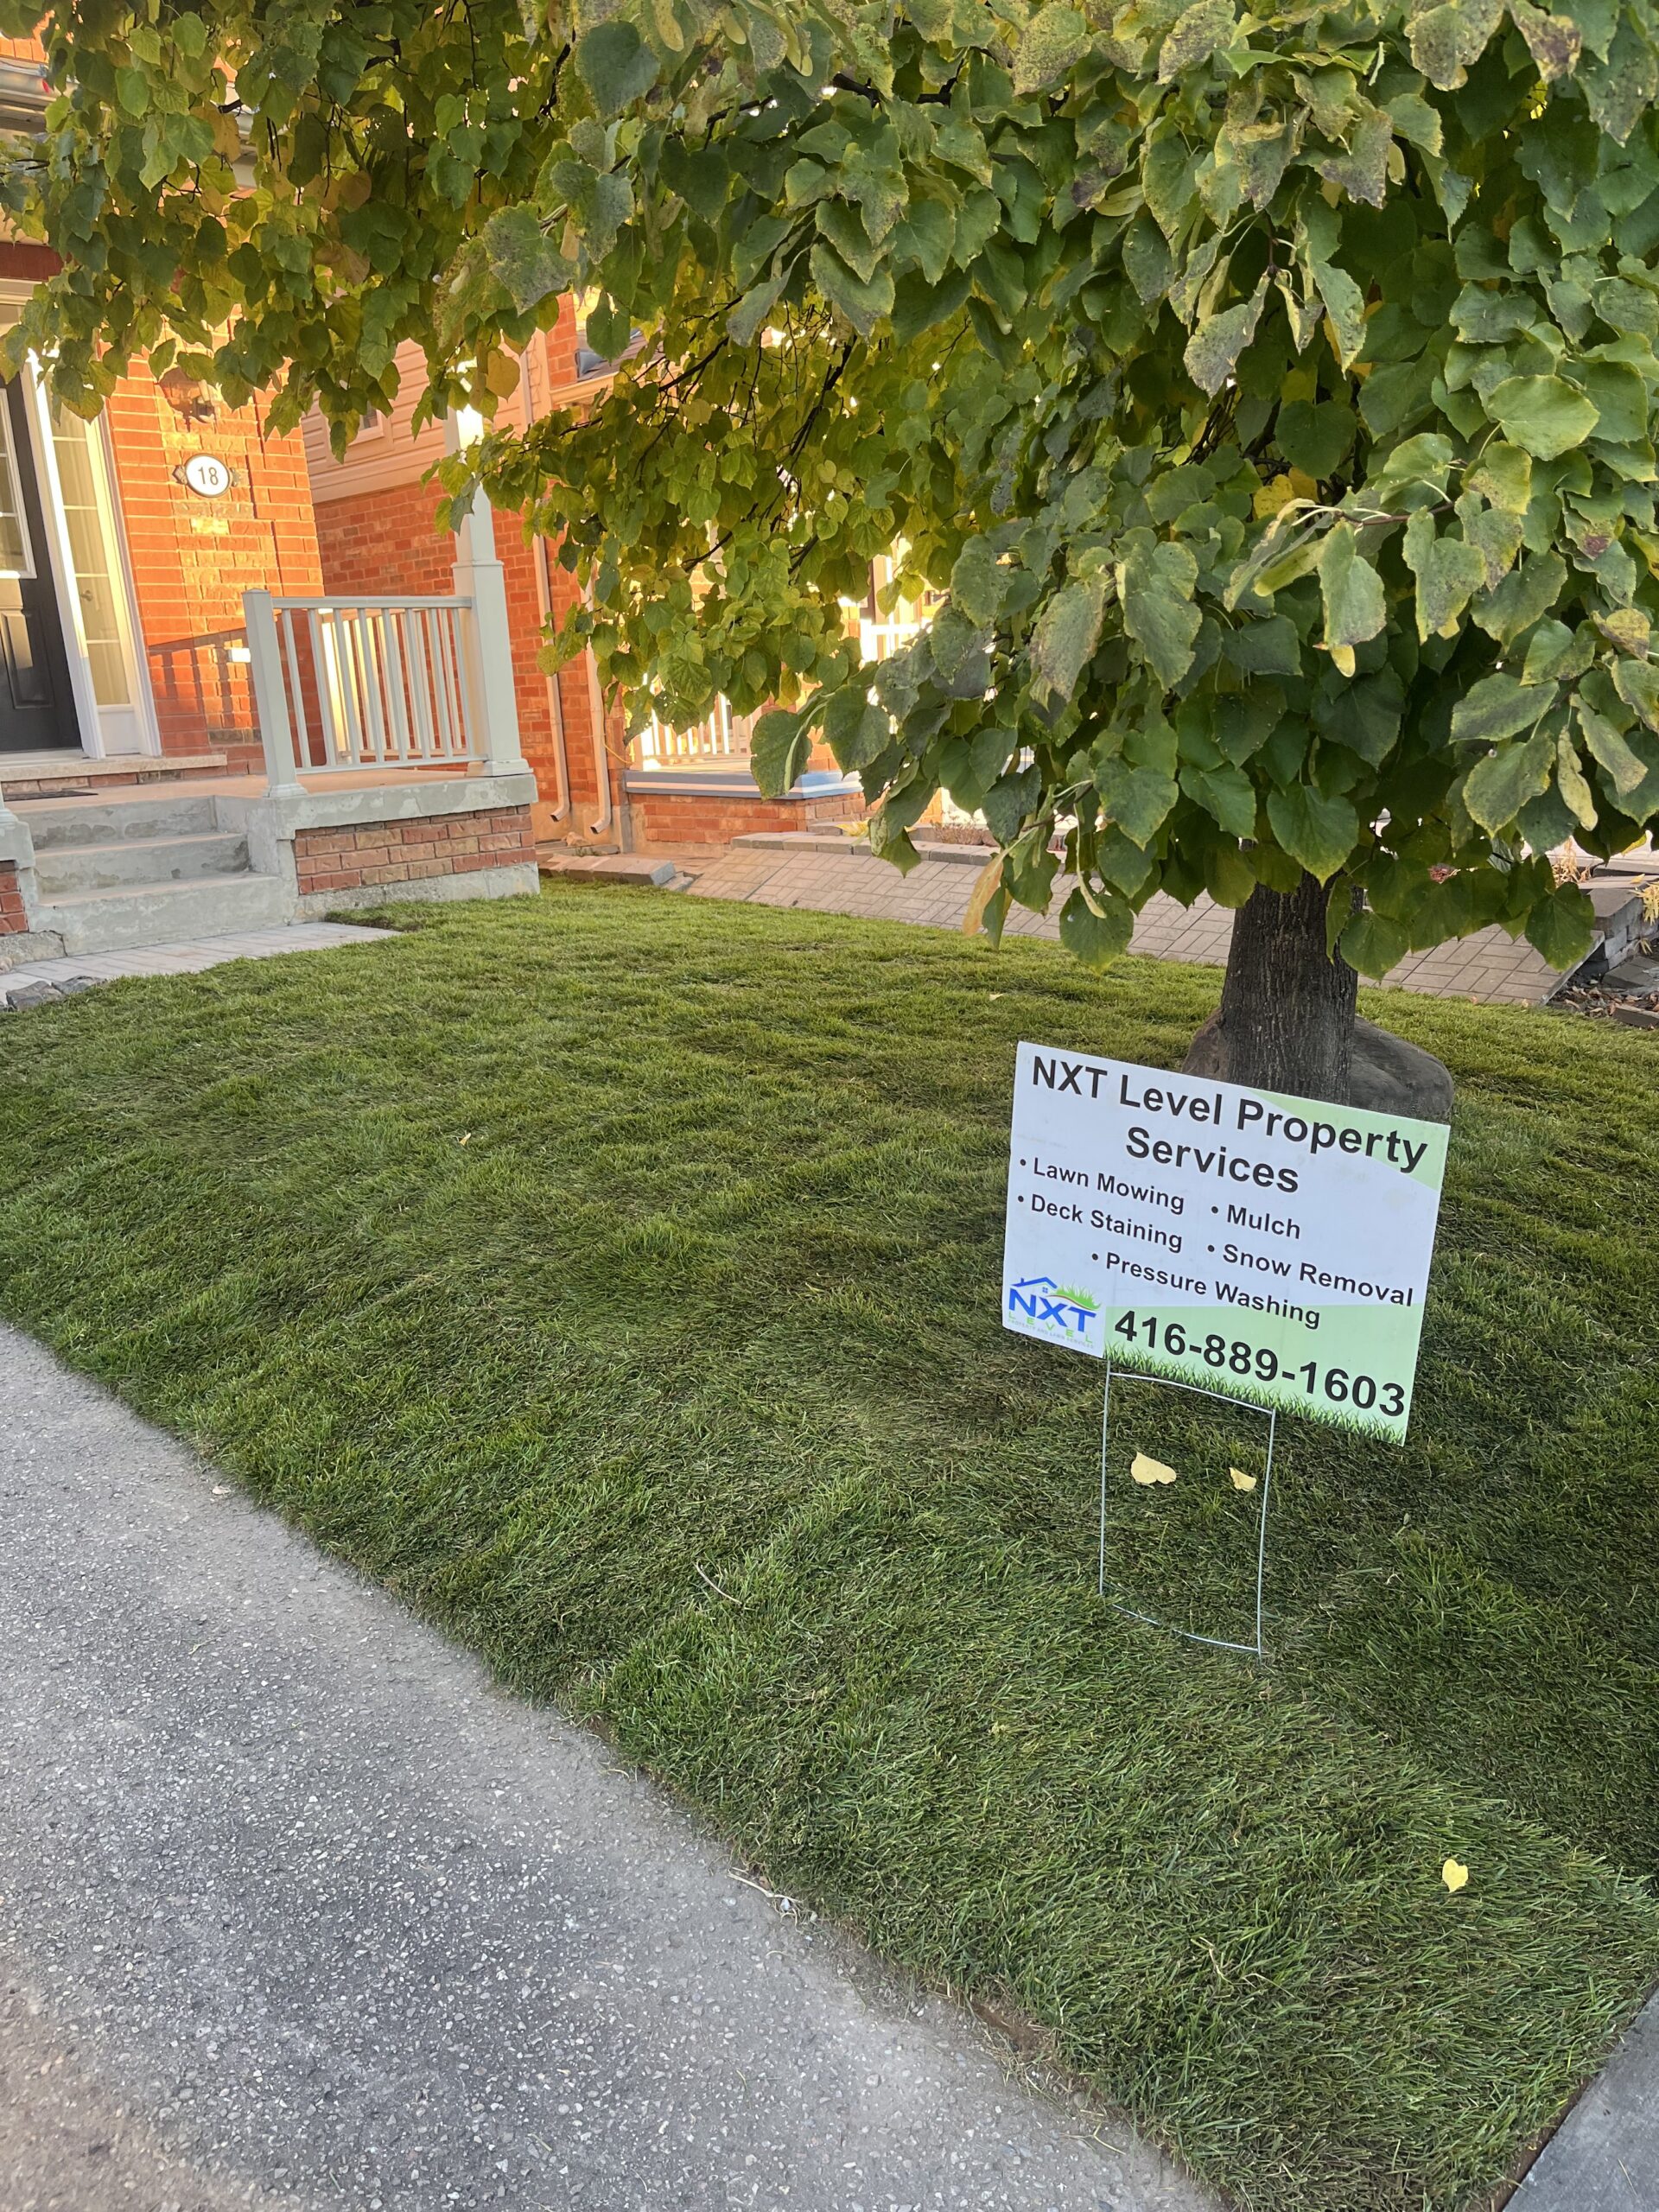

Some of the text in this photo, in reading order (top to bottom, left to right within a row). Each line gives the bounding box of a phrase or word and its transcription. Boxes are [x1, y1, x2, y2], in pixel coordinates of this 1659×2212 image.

[198, 467, 219, 486] 18
[1033, 1056, 1428, 1173] NXT Level Property
[1033, 1157, 1185, 1215] Lawn Mowing
[1126, 1127, 1299, 1193] Services
[1032, 1193, 1182, 1253] Deck Staining
[1227, 1204, 1300, 1239] Mulch
[1106, 1252, 1320, 1330] Pressure Washing
[1223, 1243, 1414, 1306] Snow Removal
[1008, 1312, 1093, 1344] LEVEL
[1009, 1287, 1097, 1332] NXT
[1115, 1310, 1405, 1417] 416-889-1603
